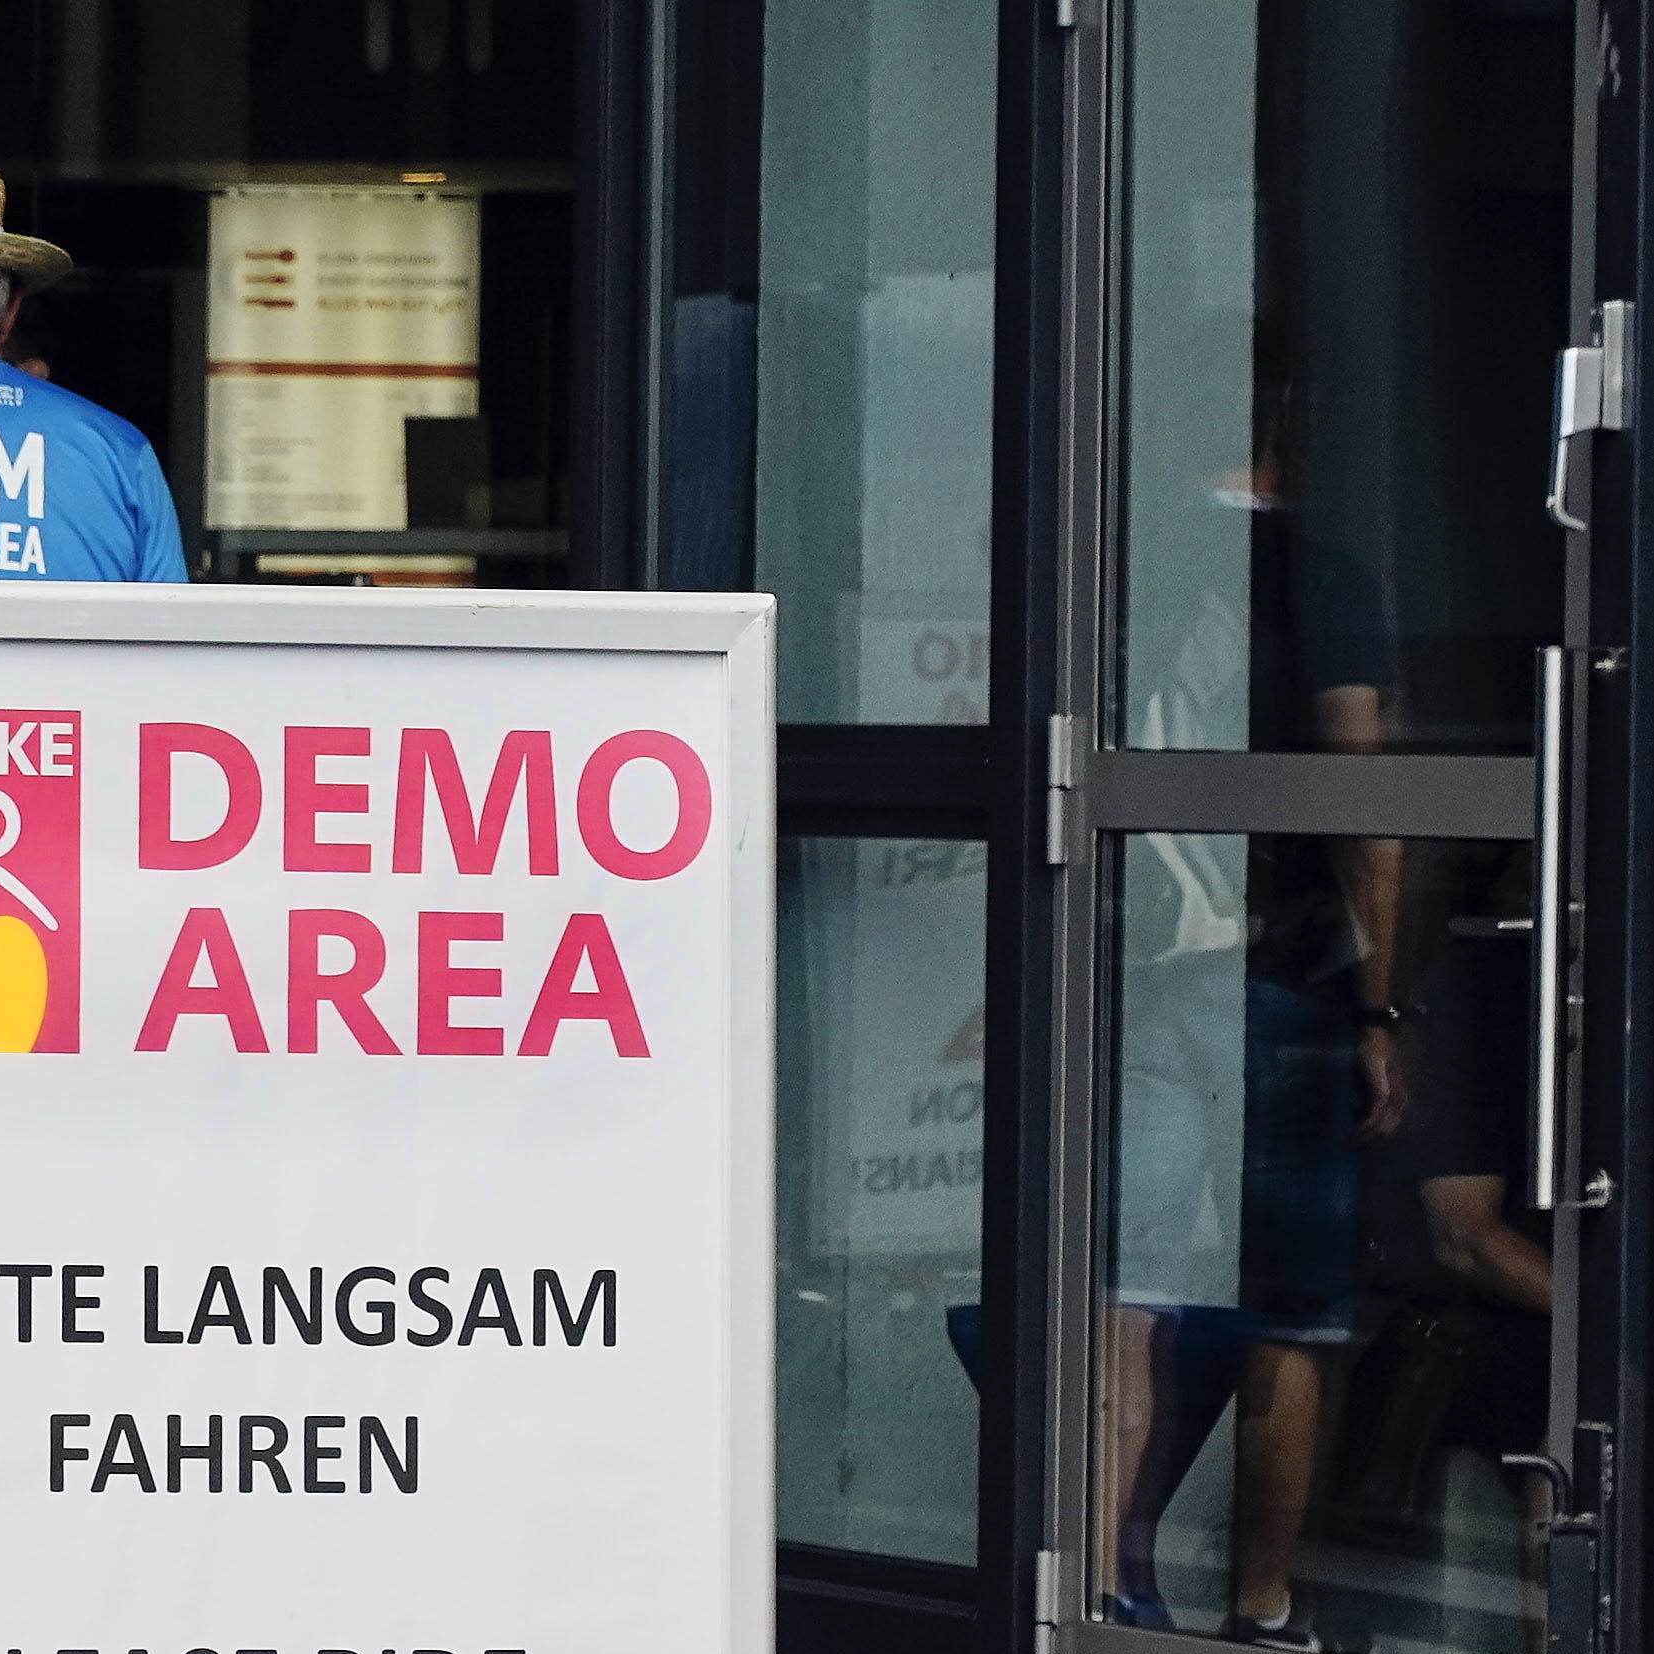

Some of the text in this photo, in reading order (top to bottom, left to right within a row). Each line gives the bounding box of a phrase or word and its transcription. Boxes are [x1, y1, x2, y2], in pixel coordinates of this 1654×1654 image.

[138, 722, 712, 881] DEMO
[133, 907, 651, 1058] AREA
[144, 1265, 618, 1348] LANGSAM
[49, 1413, 420, 1494] FAHREN
